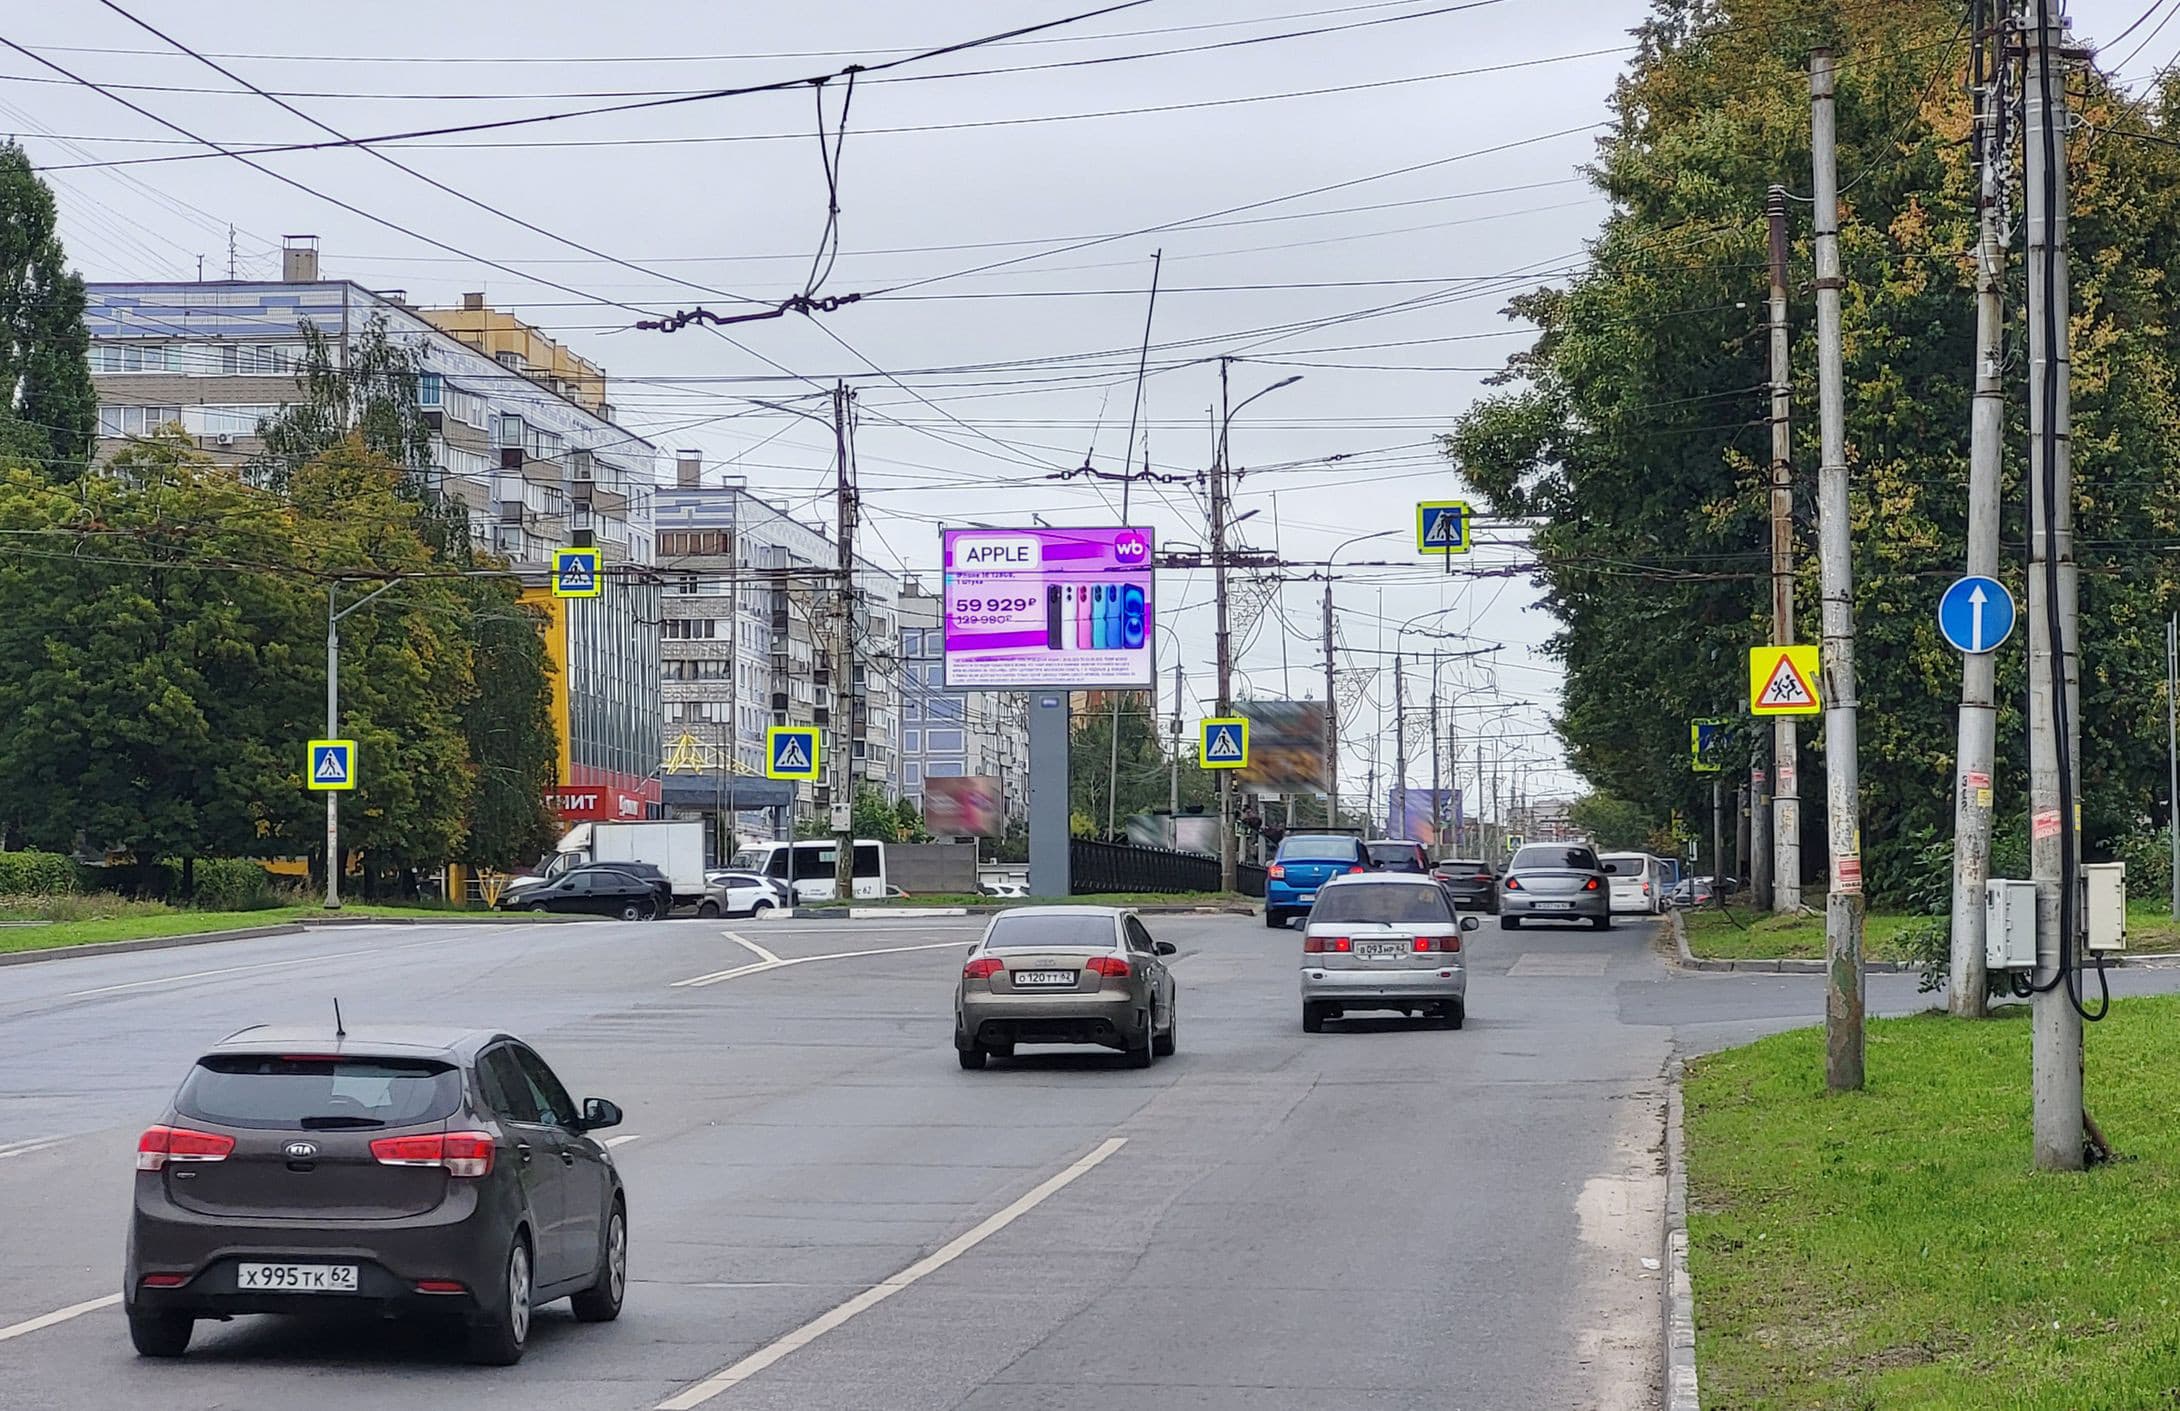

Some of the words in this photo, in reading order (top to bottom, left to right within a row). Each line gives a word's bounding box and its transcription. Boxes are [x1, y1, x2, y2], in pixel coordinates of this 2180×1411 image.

[967, 546, 1029, 562] APPLE
[1116, 540, 1144, 555] wb
[956, 599, 982, 612] 59
[290, 1146, 310, 1155] KIA
[331, 1267, 351, 1282] 62
